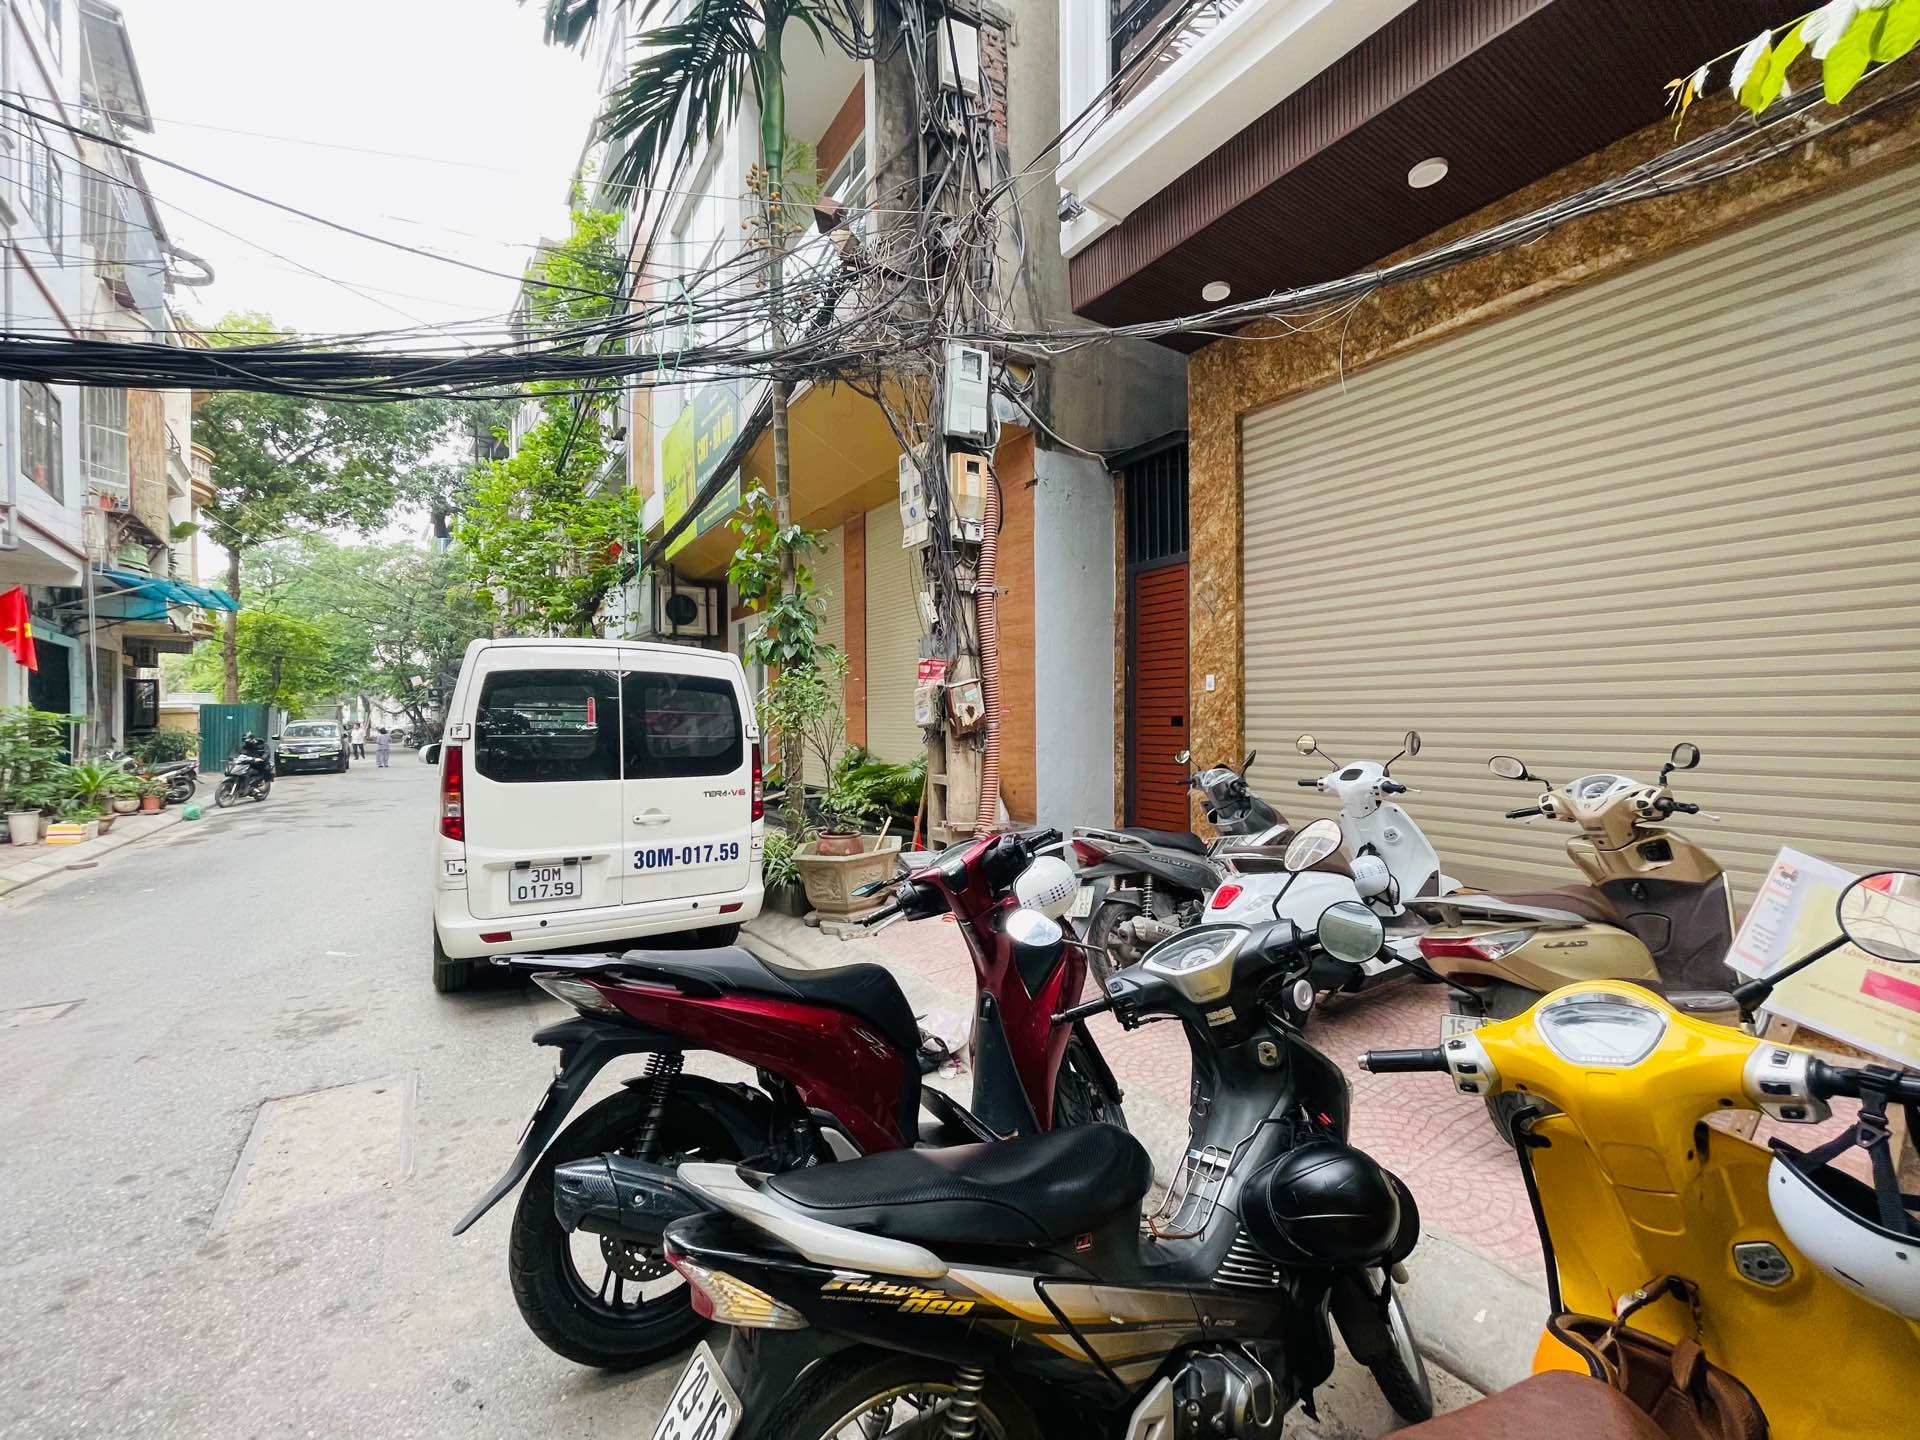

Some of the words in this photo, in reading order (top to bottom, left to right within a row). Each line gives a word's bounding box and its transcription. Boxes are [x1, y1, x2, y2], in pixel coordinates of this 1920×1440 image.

[633, 842, 739, 870] 30M-017.59
[531, 867, 561, 883] 30M
[517, 881, 574, 900] 017.59
